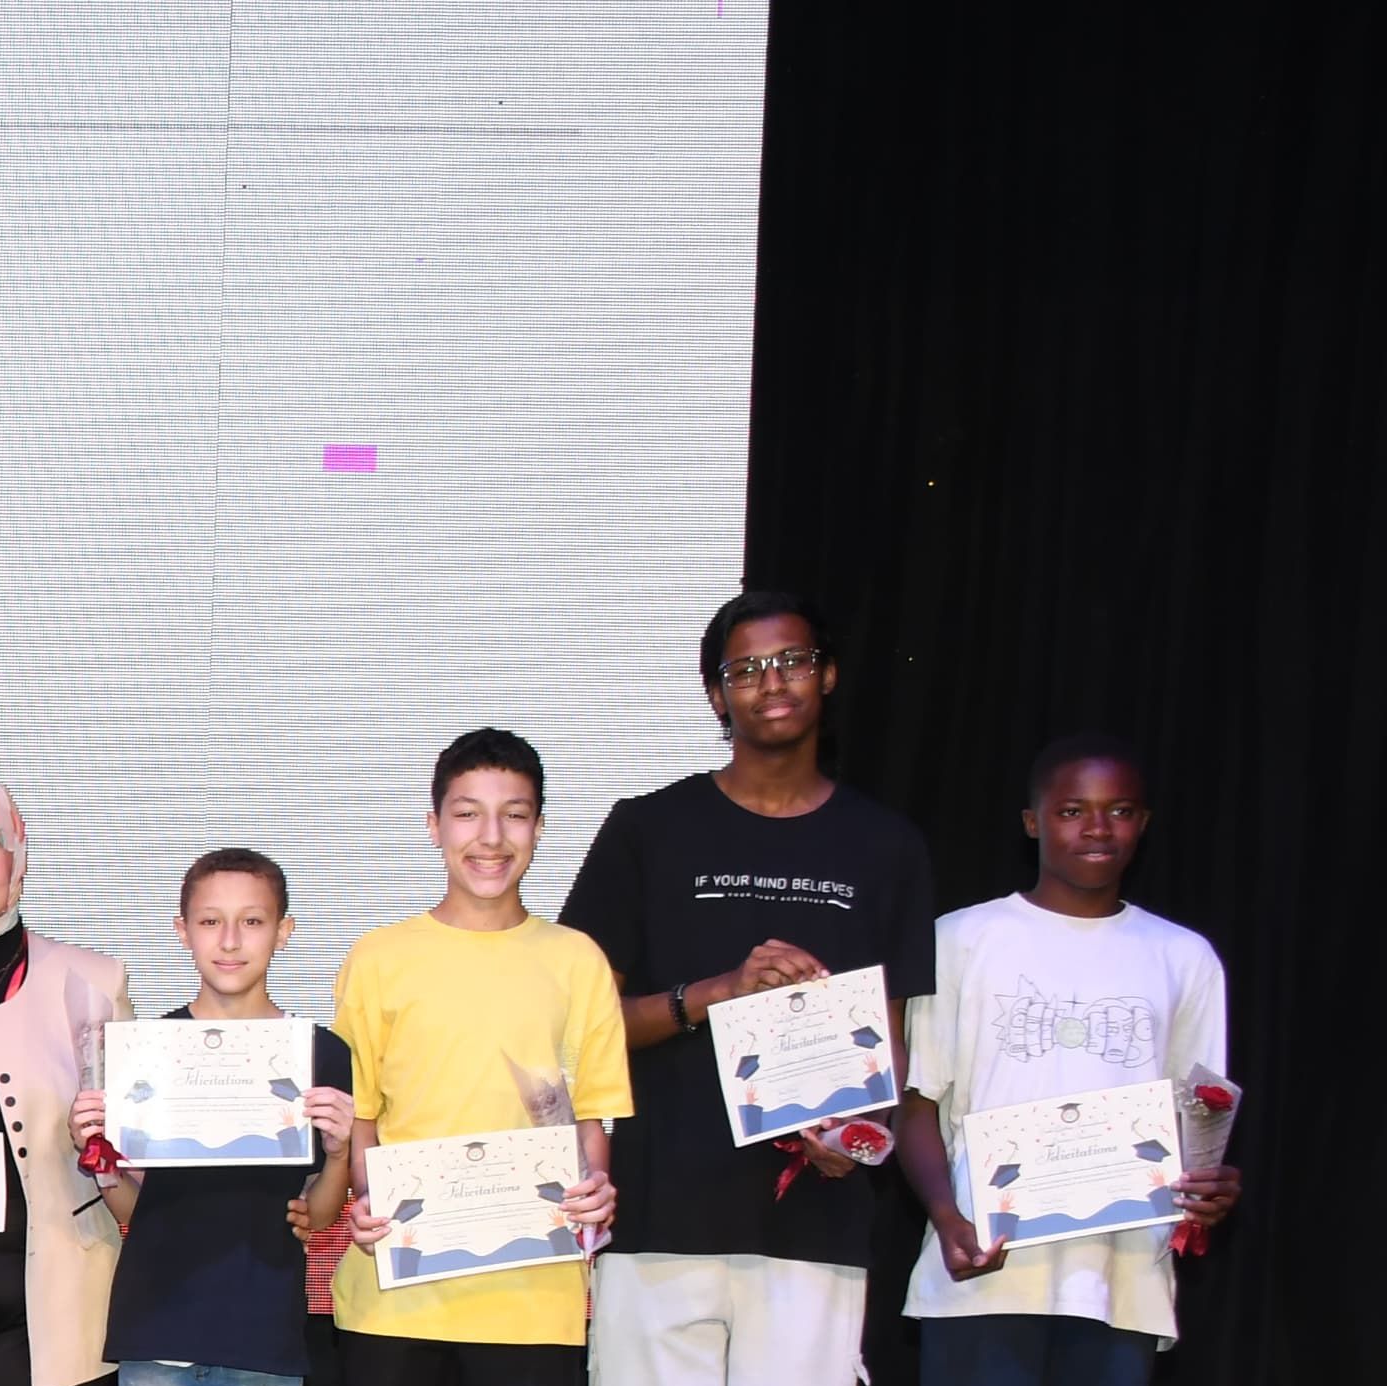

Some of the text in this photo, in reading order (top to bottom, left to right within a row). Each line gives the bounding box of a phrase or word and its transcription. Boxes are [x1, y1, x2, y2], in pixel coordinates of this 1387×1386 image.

[695, 875, 708, 887] IF
[712, 874, 750, 887] YOUR
[753, 876, 787, 890] MIND
[792, 878, 855, 898] BELIEVES
